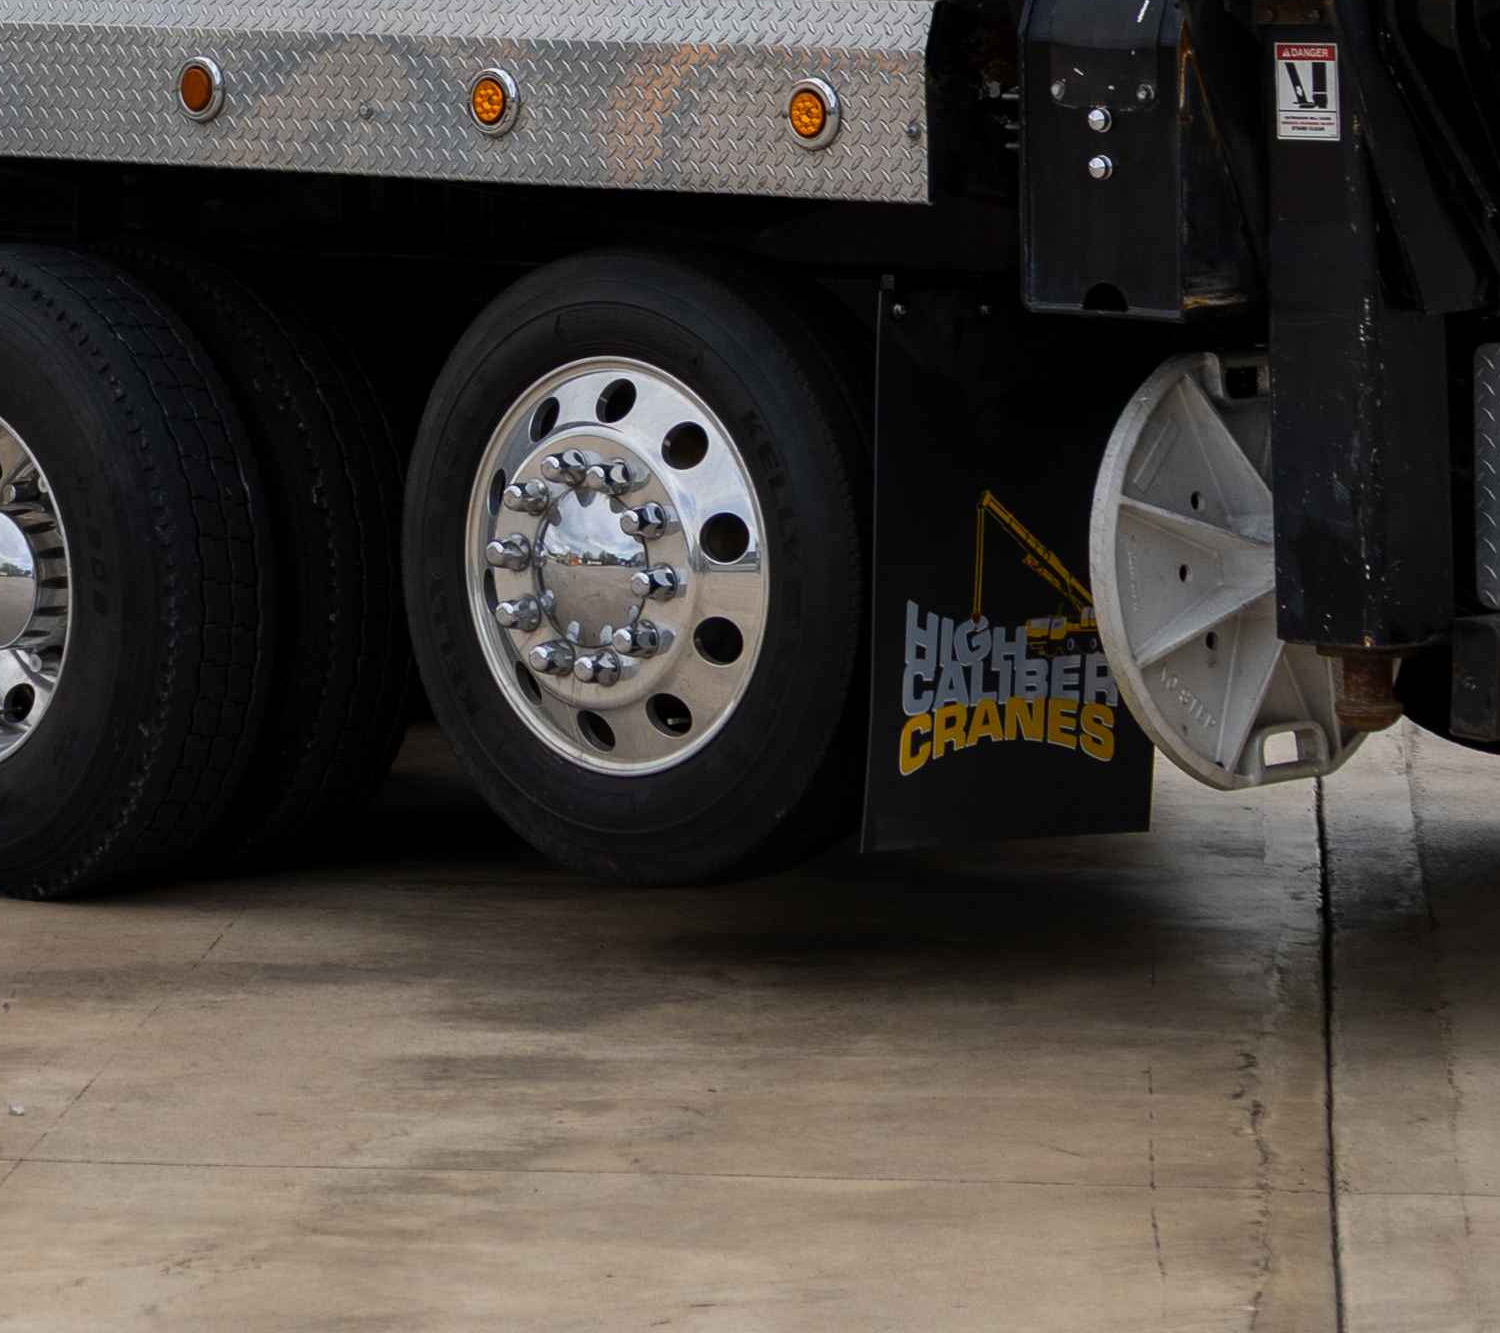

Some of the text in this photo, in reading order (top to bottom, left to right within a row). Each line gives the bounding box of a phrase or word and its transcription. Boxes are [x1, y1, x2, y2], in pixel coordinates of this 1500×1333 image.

[1289, 47, 1329, 57] DANGER
[905, 599, 1028, 670] HIGH
[902, 653, 1118, 717] CALIBER
[899, 696, 1116, 776] CRANES
